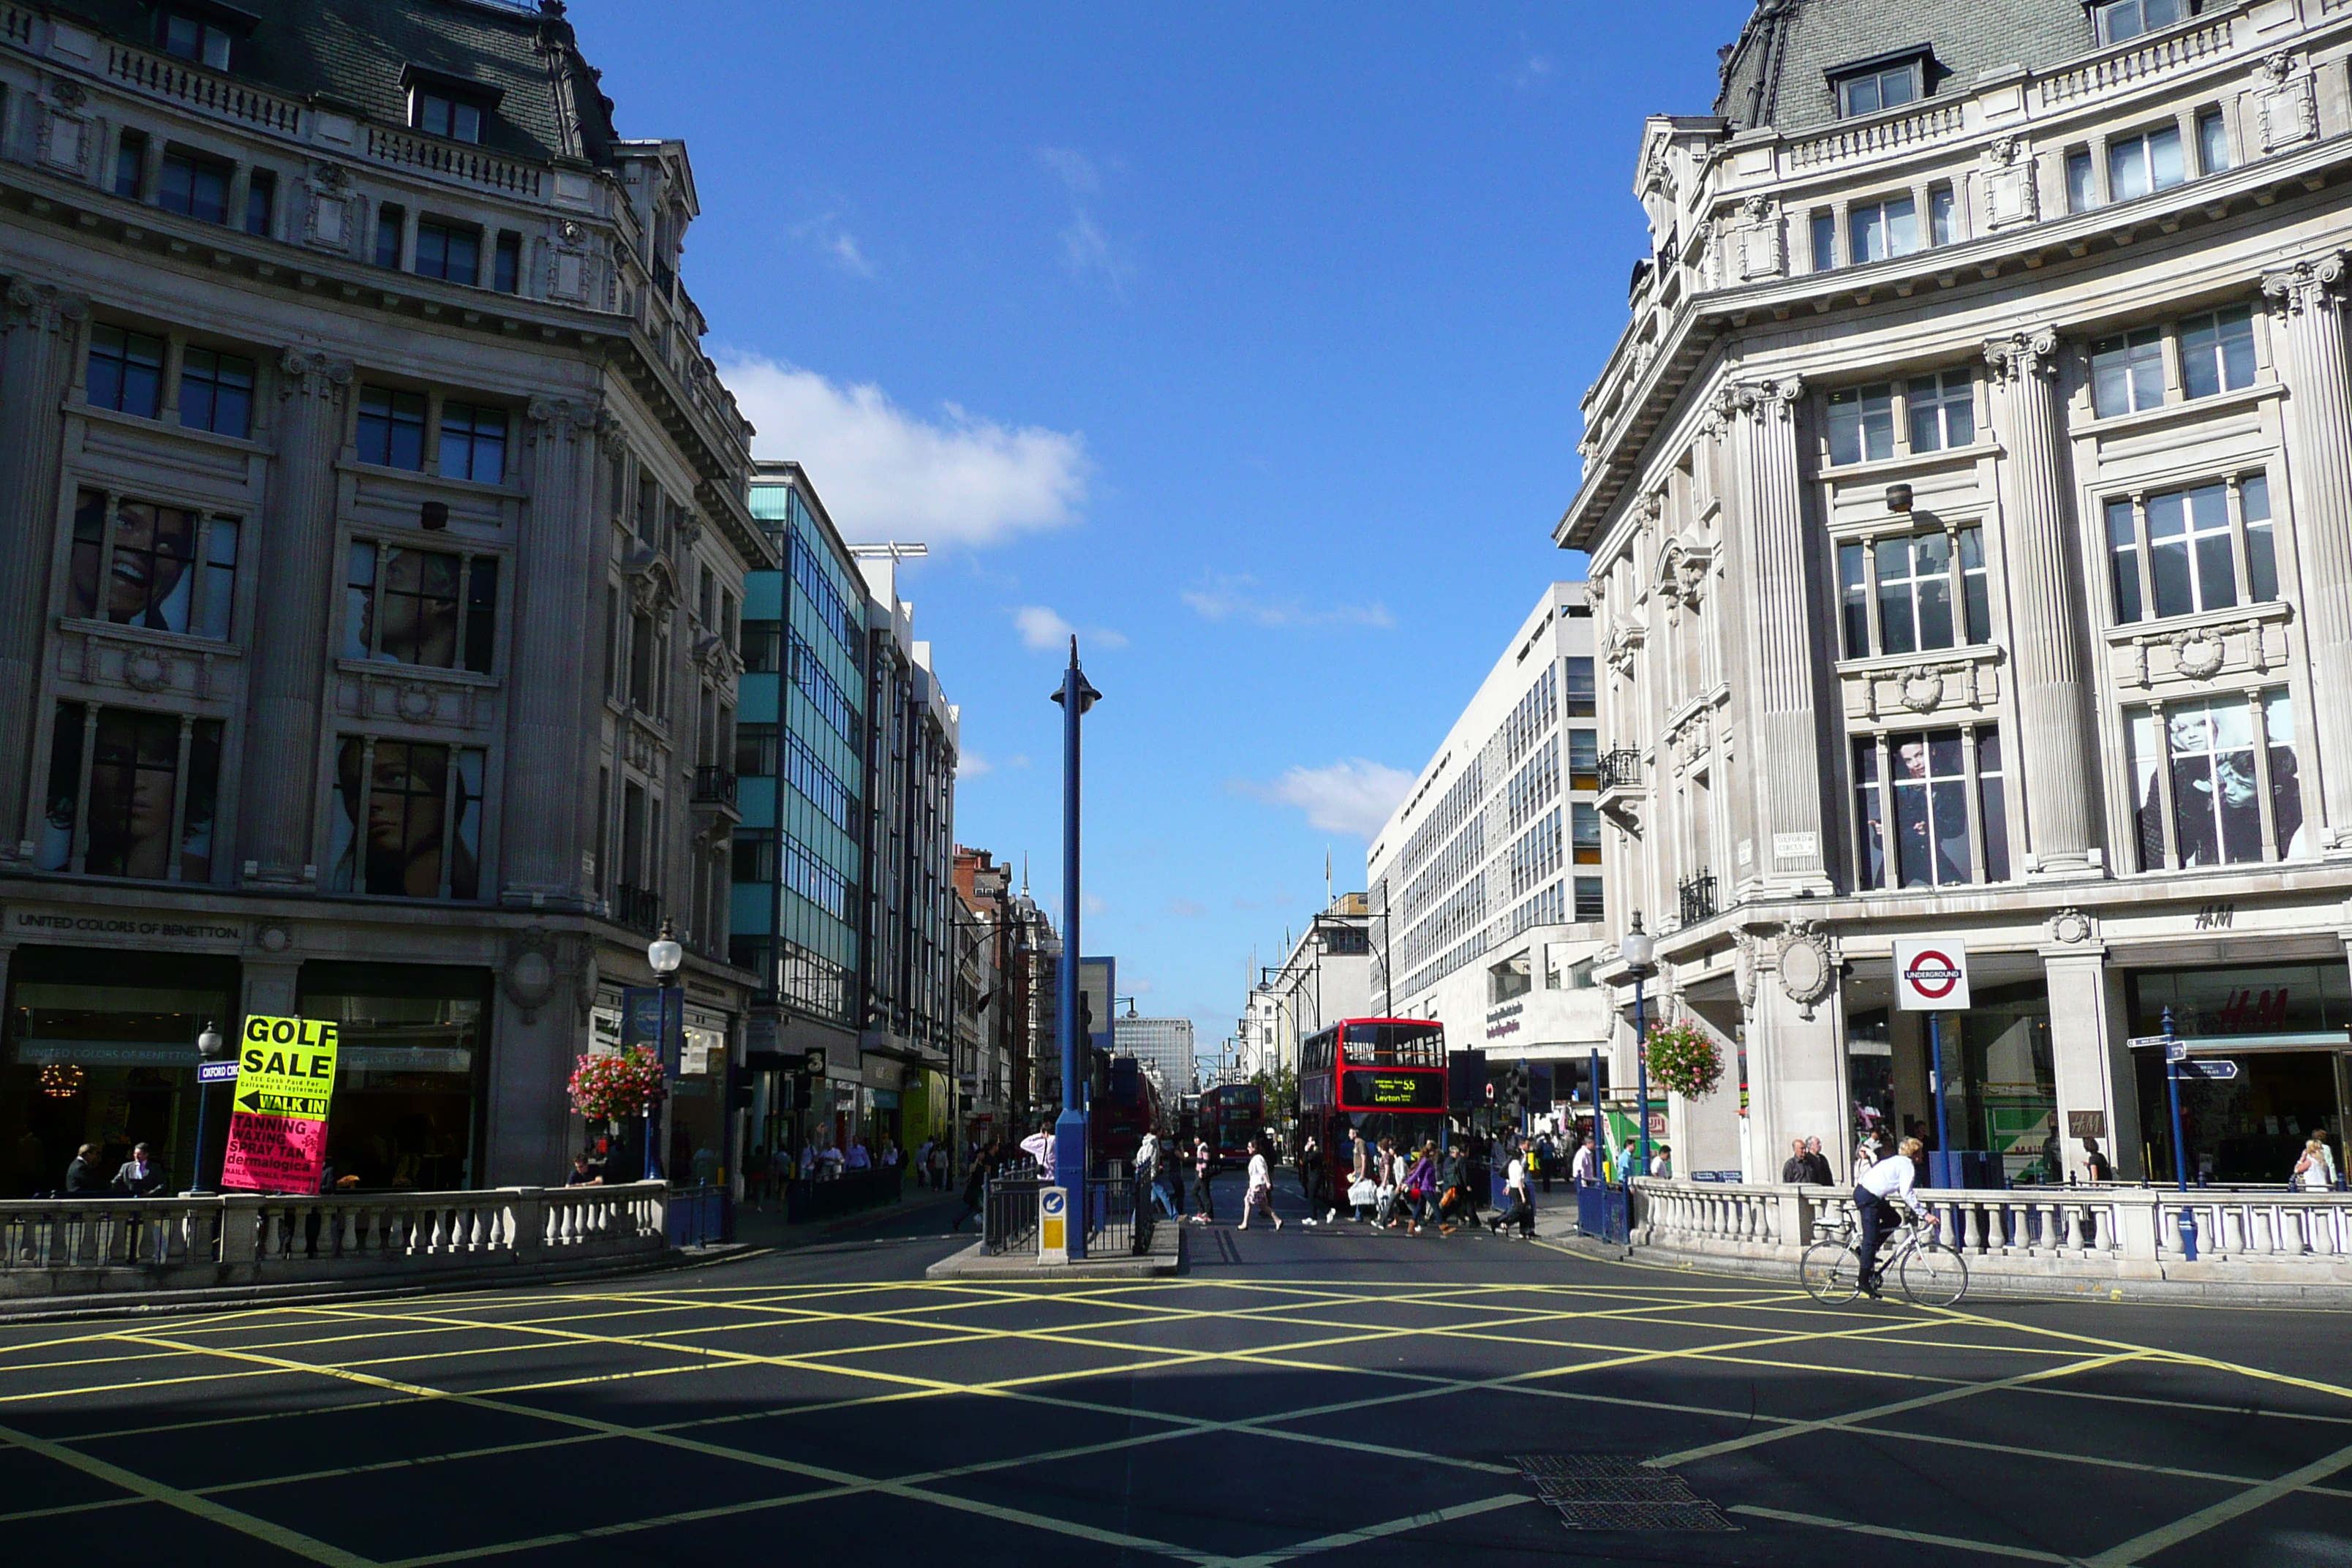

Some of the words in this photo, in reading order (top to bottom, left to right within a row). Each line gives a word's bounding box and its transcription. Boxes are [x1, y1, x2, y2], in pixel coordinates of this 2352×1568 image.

[1778, 835, 1807, 843] OXFORD
[1778, 843, 1803, 851] CIRCUS
[18, 914, 73, 929] UNITED
[76, 918, 136, 933] COLORS
[140, 922, 158, 935] OF
[2194, 903, 2234, 930] H&M
[1906, 970, 1959, 979] UNDERGROUND
[246, 1019, 338, 1047] GOLF
[244, 1049, 332, 1079] SALE
[807, 1052, 823, 1072] 3
[203, 1066, 226, 1078] OXFORD
[241, 1082, 273, 1090] Callaway
[1403, 1079, 1415, 1090] 55
[260, 1095, 304, 1112] WALK
[308, 1099, 325, 1113] IN
[1375, 1093, 1401, 1103] Leyton
[234, 1115, 306, 1134] TANNING
[231, 1128, 287, 1145] WAXING
[229, 1141, 274, 1156] SPRAY
[279, 1146, 306, 1159] TAN
[227, 1153, 311, 1173] dermalogica
